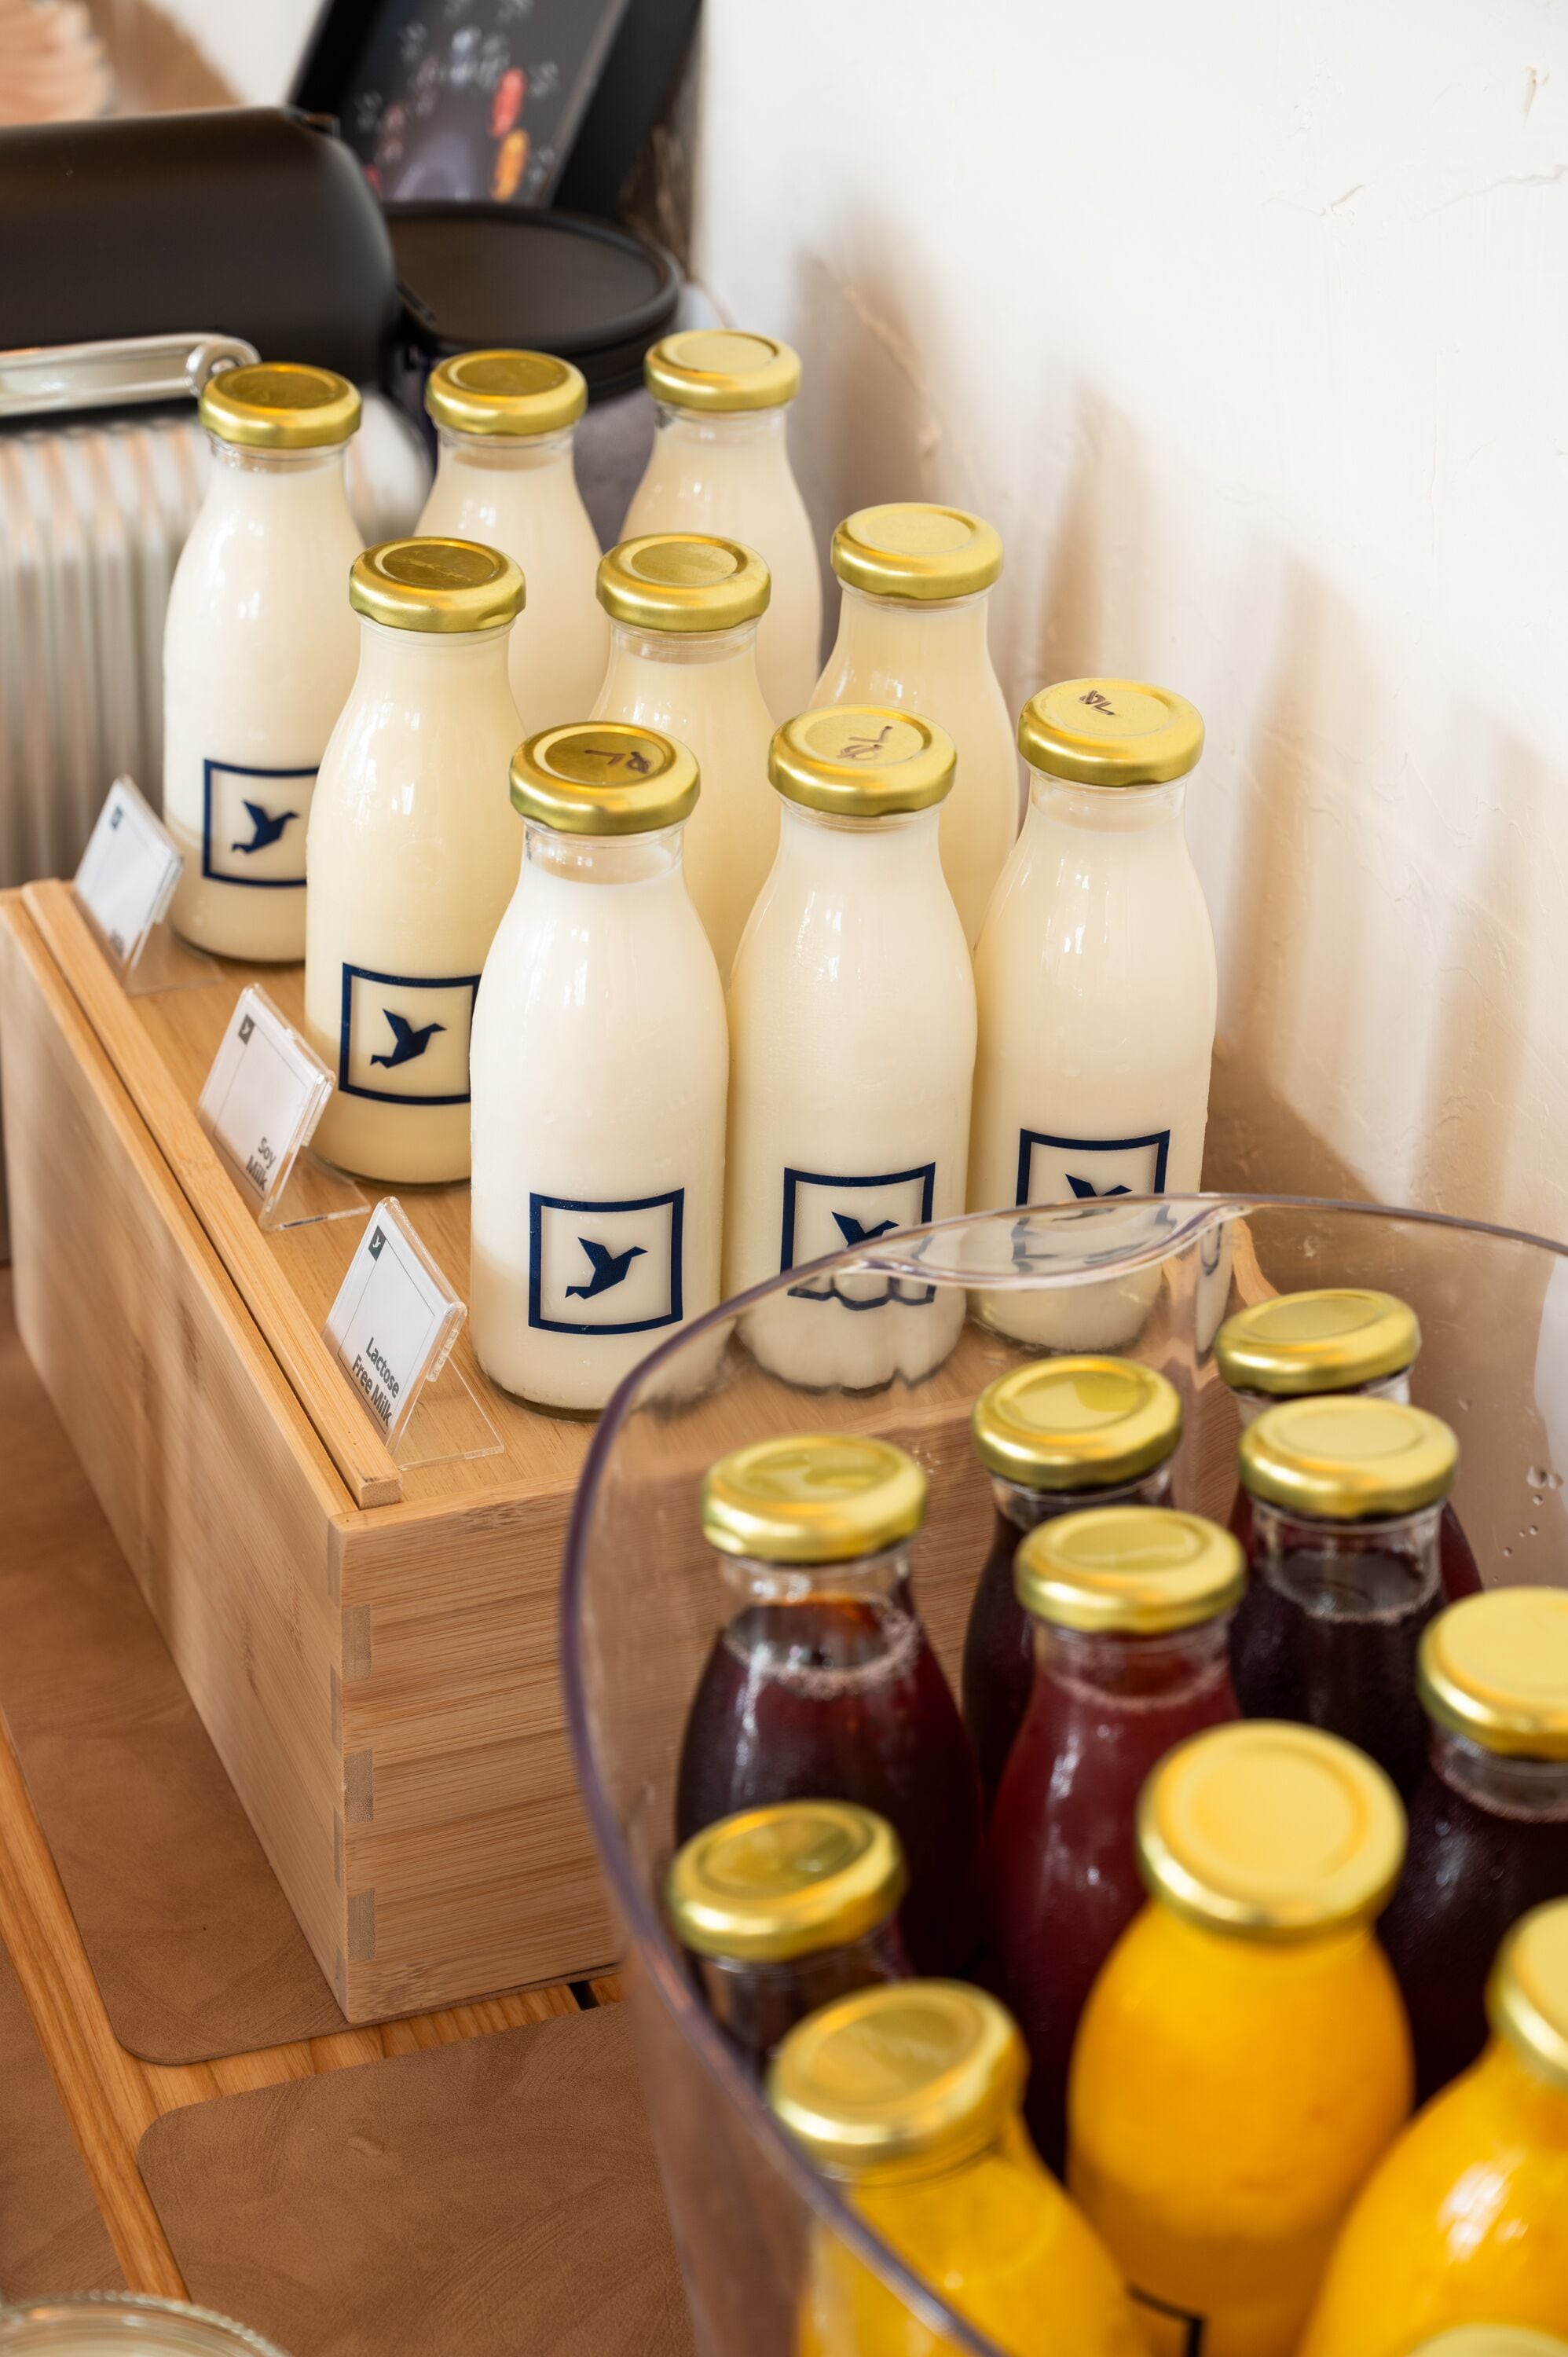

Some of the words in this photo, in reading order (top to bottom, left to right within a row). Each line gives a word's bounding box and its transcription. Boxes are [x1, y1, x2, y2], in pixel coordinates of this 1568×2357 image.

[246, 1155, 268, 1192] Milk
[258, 1137, 277, 1169] Soy
[351, 1354, 373, 1395] Free
[370, 1386, 393, 1428] Milk
[365, 1336, 400, 1398] Lactose
